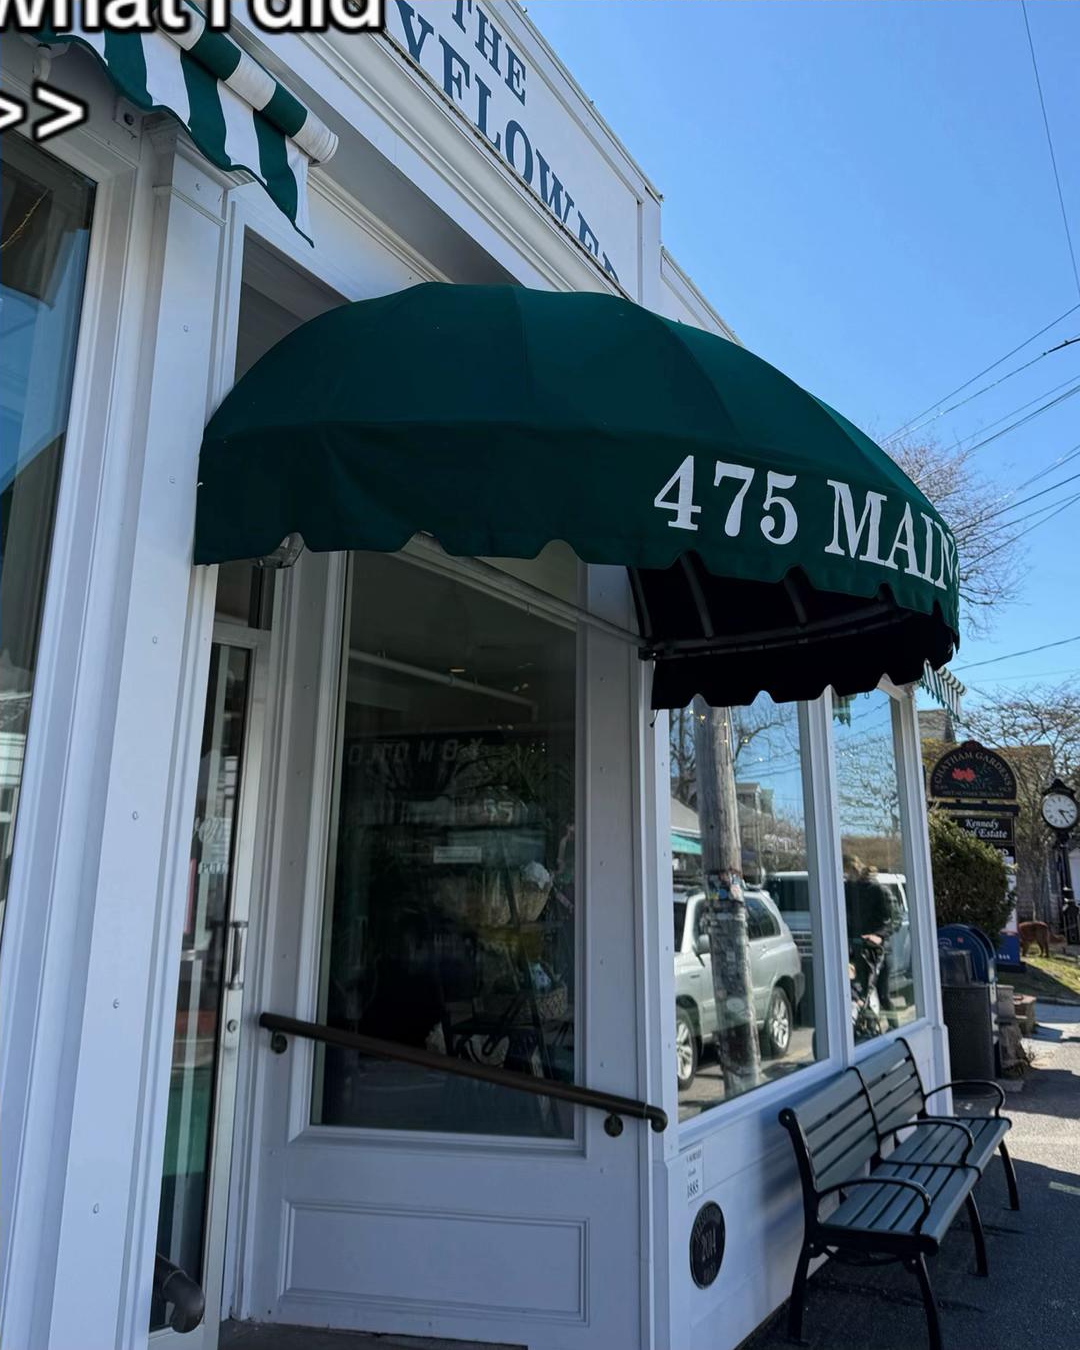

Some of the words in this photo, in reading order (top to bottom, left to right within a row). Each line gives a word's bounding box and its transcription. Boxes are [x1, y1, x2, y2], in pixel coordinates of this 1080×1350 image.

[395, 0, 621, 283] YFLOWE
[653, 454, 799, 546] 475
[824, 478, 955, 591] MAIN
[934, 751, 973, 784] CHATHAM
[975, 751, 1012, 788] GARDENS
[965, 818, 1000, 830] Kennedy
[978, 828, 1008, 839] Estate
